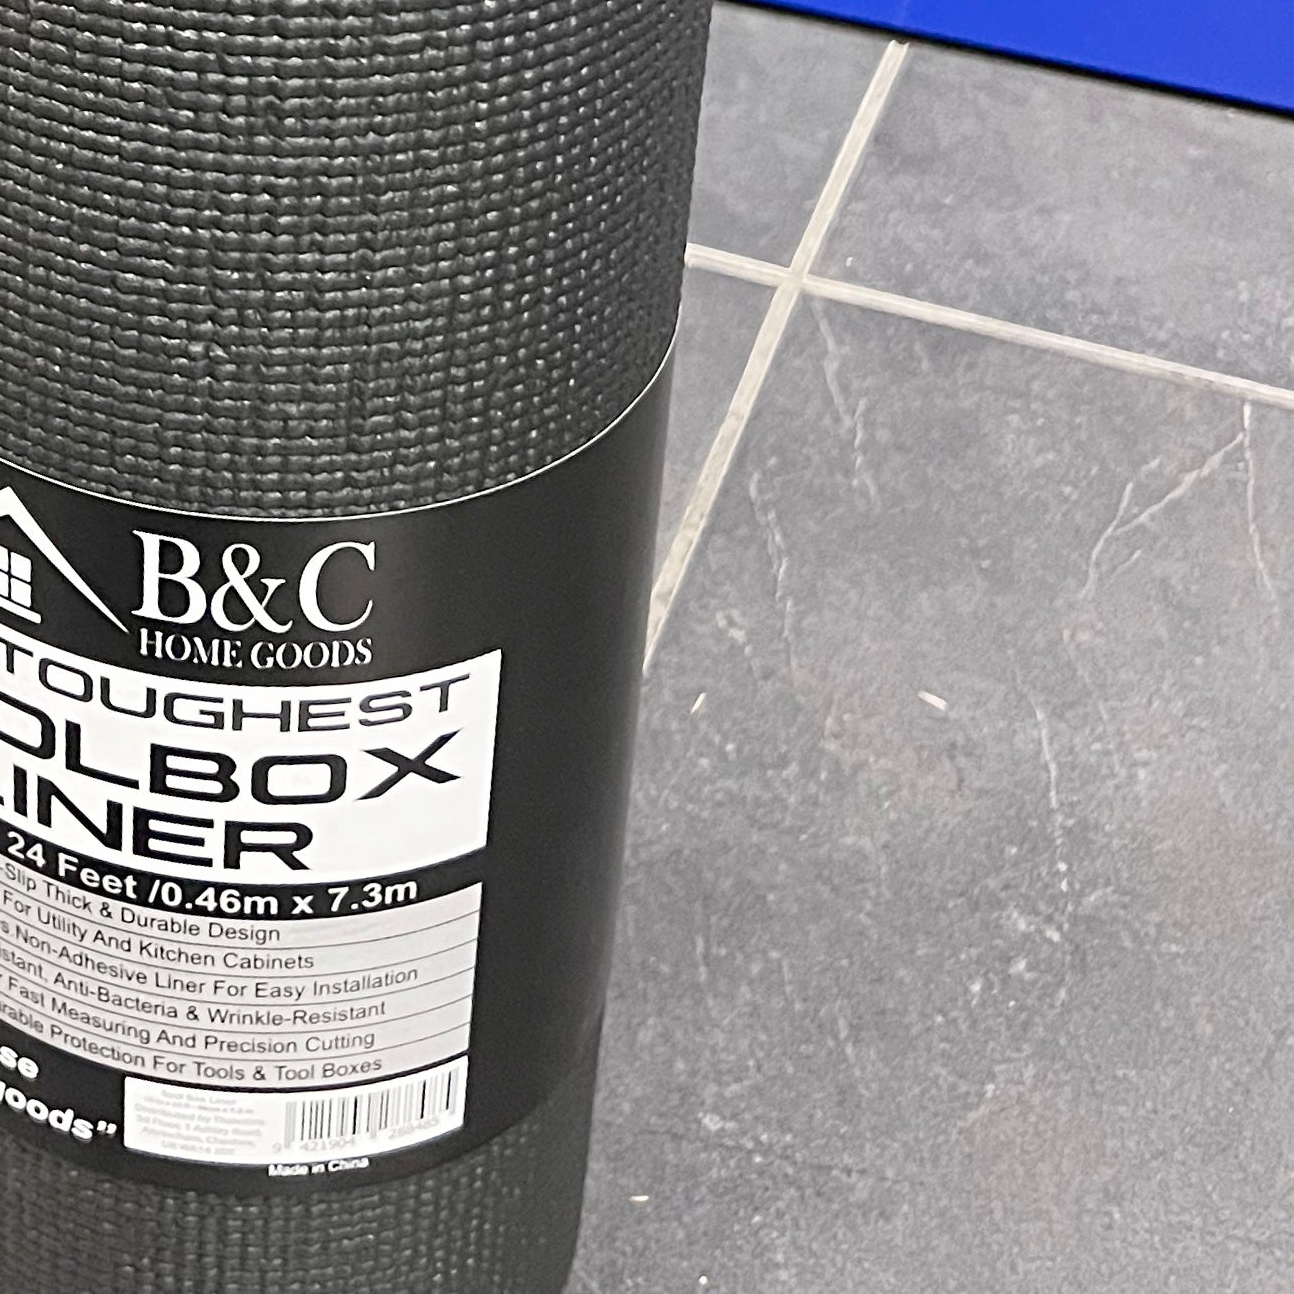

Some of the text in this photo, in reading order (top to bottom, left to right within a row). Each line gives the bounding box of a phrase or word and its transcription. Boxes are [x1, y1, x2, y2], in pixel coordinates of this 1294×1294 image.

[131, 529, 376, 634] B&C
[140, 627, 373, 669] HOME GOODS
[7, 831, 47, 869] 24
[58, 852, 138, 900] Feet
[148, 878, 279, 915] /0.46m
[291, 894, 314, 915] x
[327, 880, 418, 912] 7.3m
[3, 890, 32, 916] For
[37, 907, 88, 943] Utility
[92, 929, 132, 953] And
[139, 940, 215, 967] Kitchen
[223, 952, 314, 970] Cabinets
[42, 879, 93, 914] Thick
[99, 901, 113, 920] &
[120, 906, 201, 937] Durable
[208, 921, 281, 946] Design
[16, 924, 148, 985] Non-Adhesive
[155, 971, 207, 994] Liner
[213, 979, 248, 997] For
[255, 981, 306, 1002] Easy
[312, 968, 419, 997] Installation
[53, 971, 179, 1020] Anti-Bacteria
[186, 1004, 200, 1022] &
[207, 1001, 386, 1026] Wrinkle-Resistant
[8, 976, 46, 1007] Fast
[51, 996, 151, 1044] Measuring
[156, 1029, 197, 1049] And
[204, 1034, 298, 1054] Precision
[305, 1032, 375, 1053] Cutting
[50, 1023, 146, 1069] Protection
[153, 1055, 187, 1075] For
[193, 1060, 246, 1081] Tools
[252, 1065, 266, 1081] &
[275, 1063, 315, 1081] Tool
[322, 1058, 383, 1079] Boxes
[267, 1157, 371, 1177] Made in China
